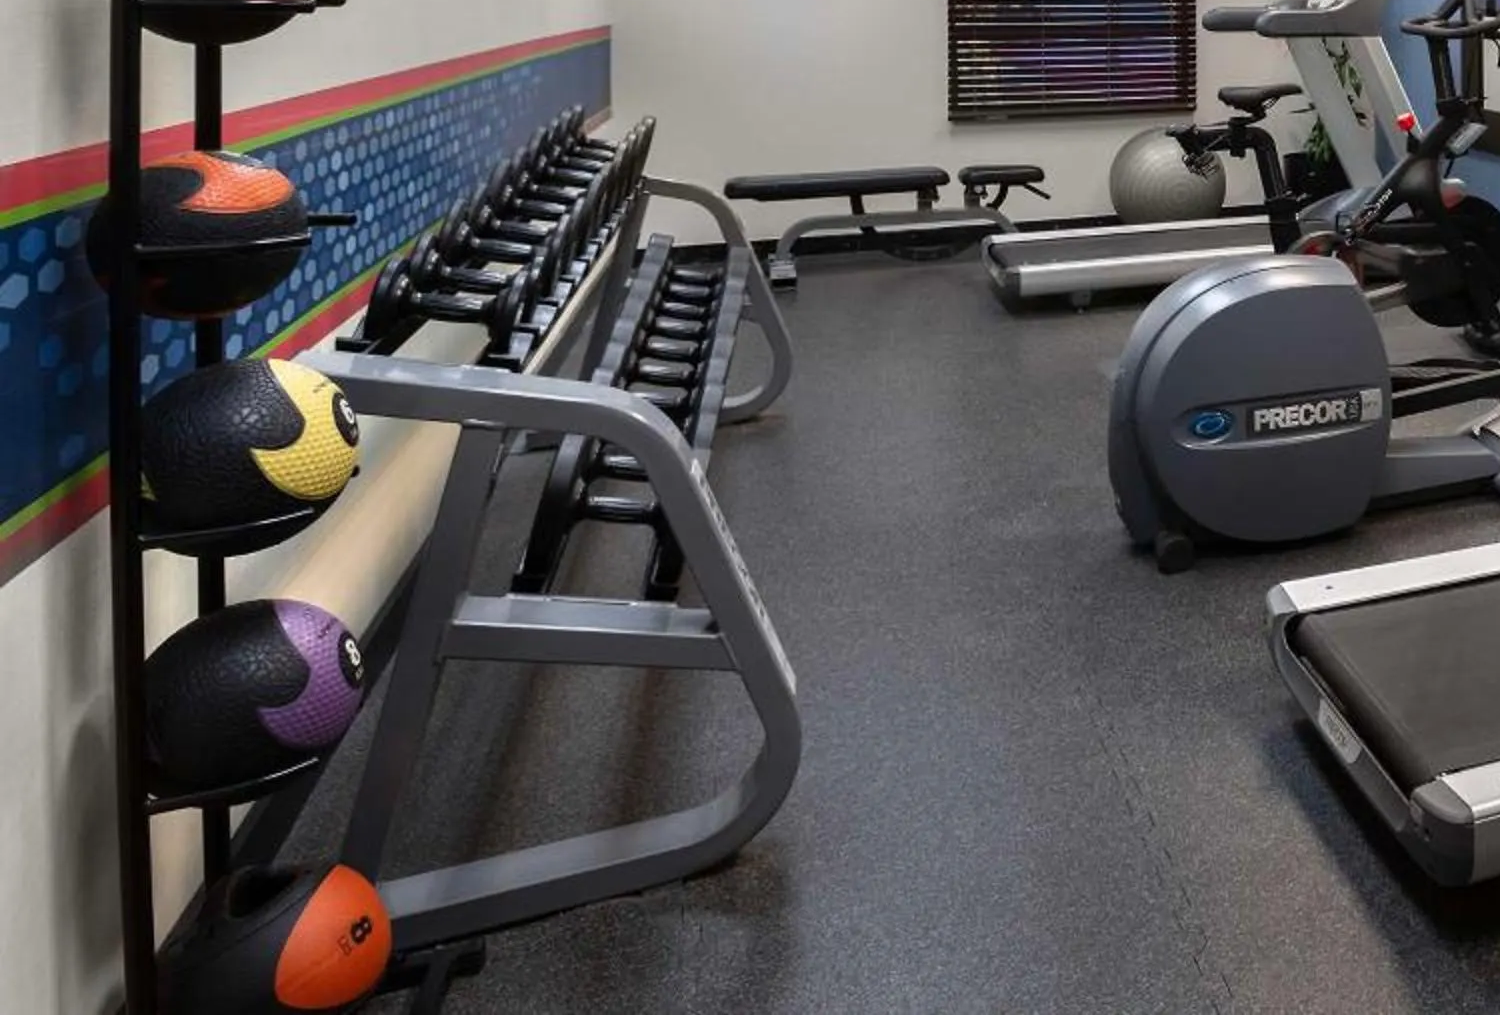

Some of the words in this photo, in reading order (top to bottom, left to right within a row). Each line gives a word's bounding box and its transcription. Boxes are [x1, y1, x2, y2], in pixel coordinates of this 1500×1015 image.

[339, 398, 355, 424] 6
[1253, 400, 1347, 433] PRECOR
[345, 638, 361, 666] 8
[350, 915, 373, 945] 8
